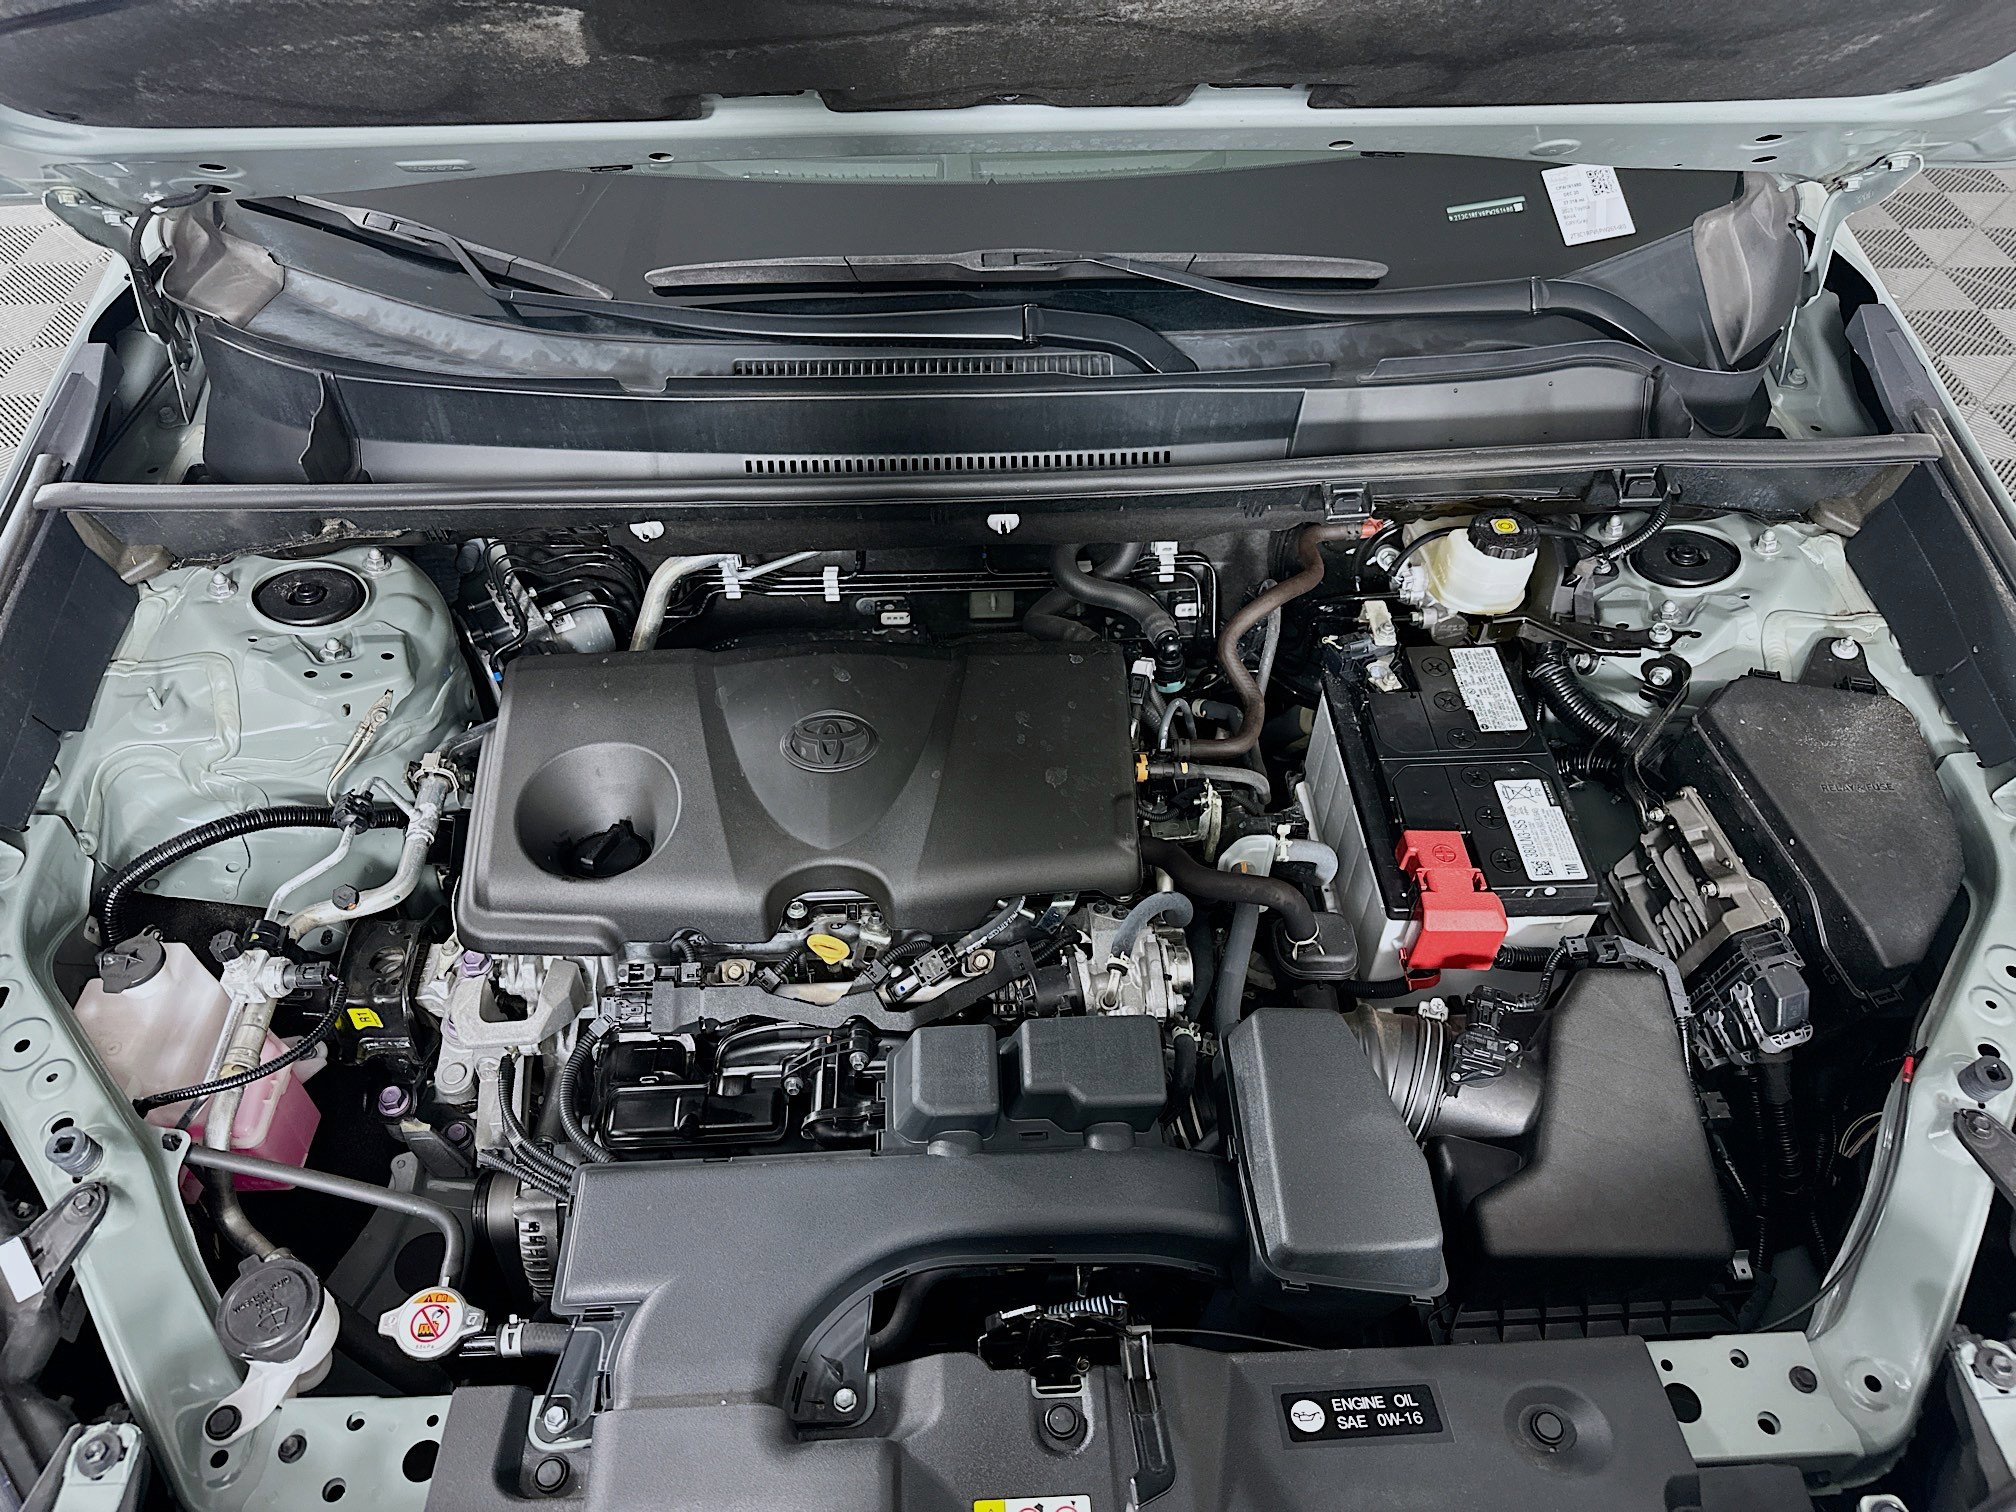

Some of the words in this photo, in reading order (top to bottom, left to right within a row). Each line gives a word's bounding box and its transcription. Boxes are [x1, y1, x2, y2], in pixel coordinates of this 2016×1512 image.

[1820, 784, 1854, 792] RELAY
[1866, 783, 1895, 791] FUSE
[1565, 864, 1581, 875] TM
[1331, 1395, 1386, 1412] ENGINE
[1393, 1393, 1419, 1408] OIL
[1336, 1414, 1369, 1430] SAE
[1377, 1411, 1424, 1427] 0W-16
